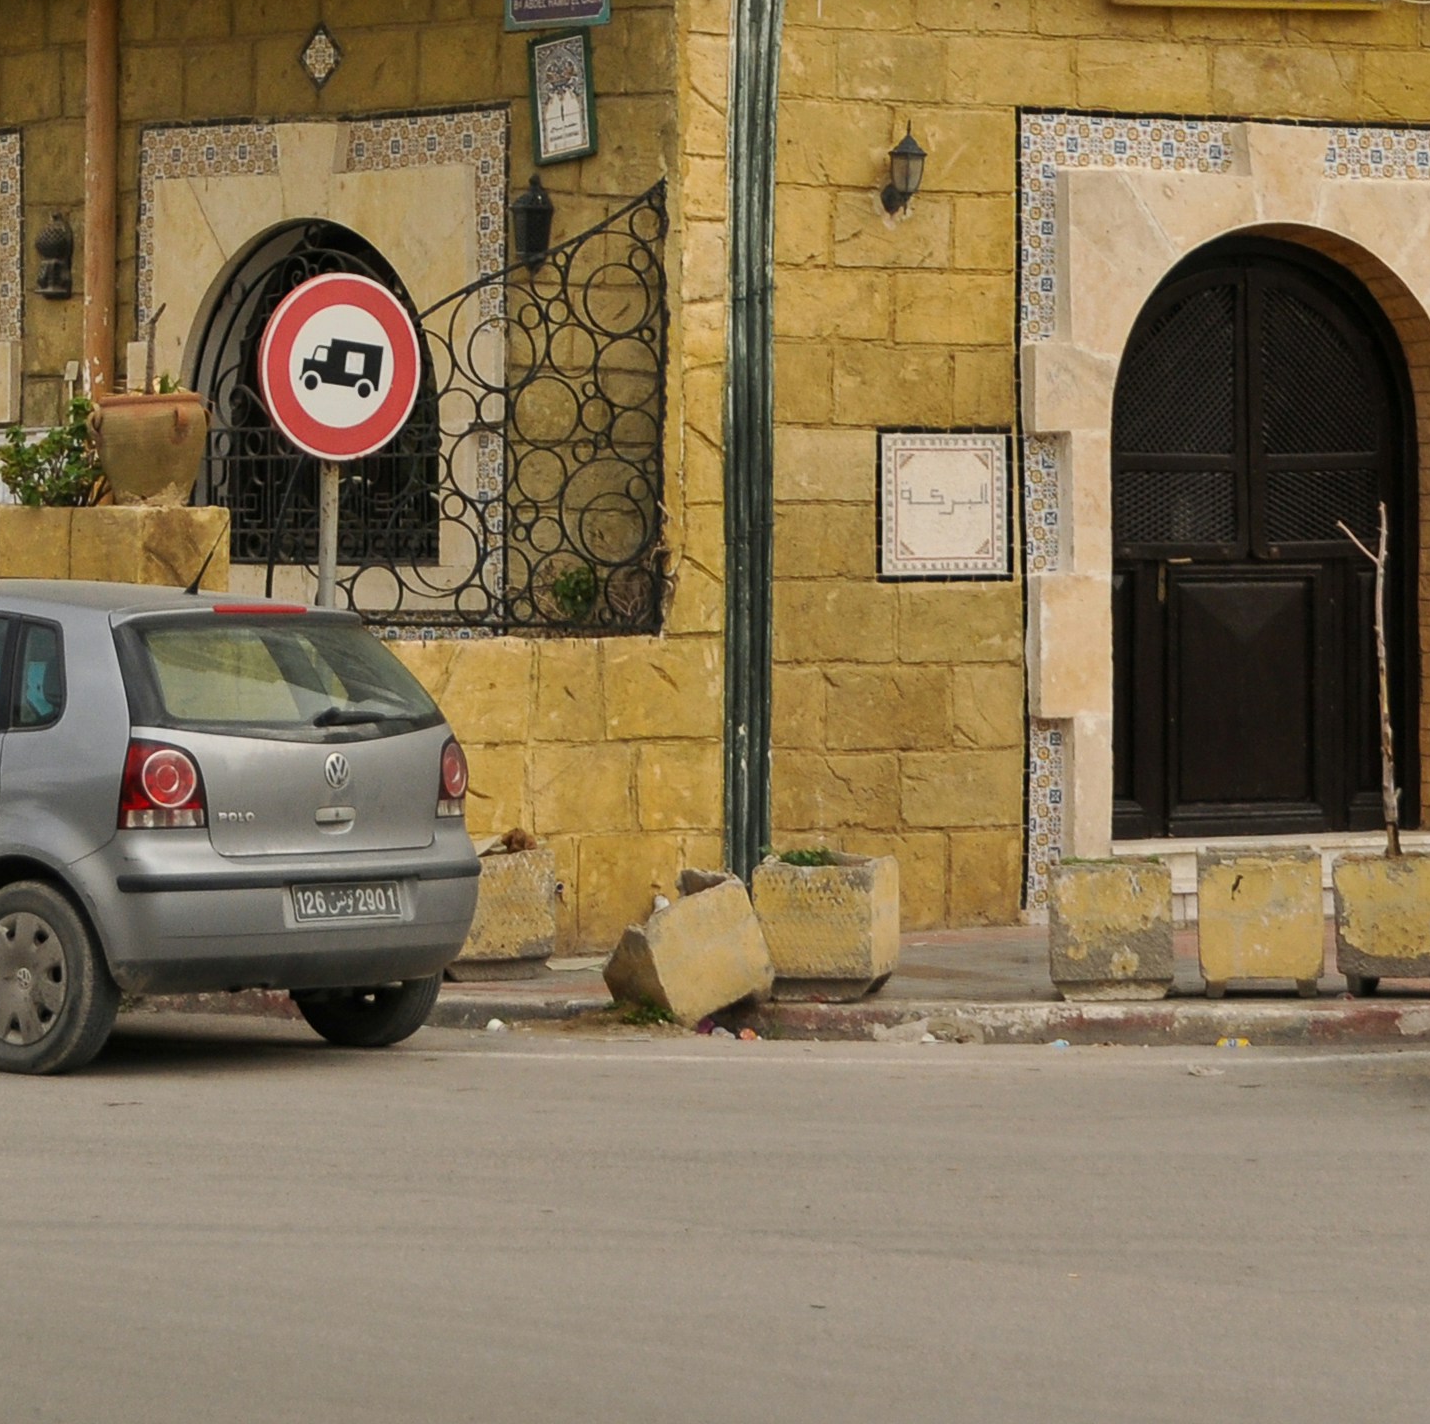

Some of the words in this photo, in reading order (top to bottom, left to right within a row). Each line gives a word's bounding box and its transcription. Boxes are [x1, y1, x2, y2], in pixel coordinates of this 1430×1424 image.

[218, 811, 255, 822] POLO
[297, 891, 326, 914] 126
[329, 890, 354, 914] تونس
[356, 887, 396, 911] 2901
